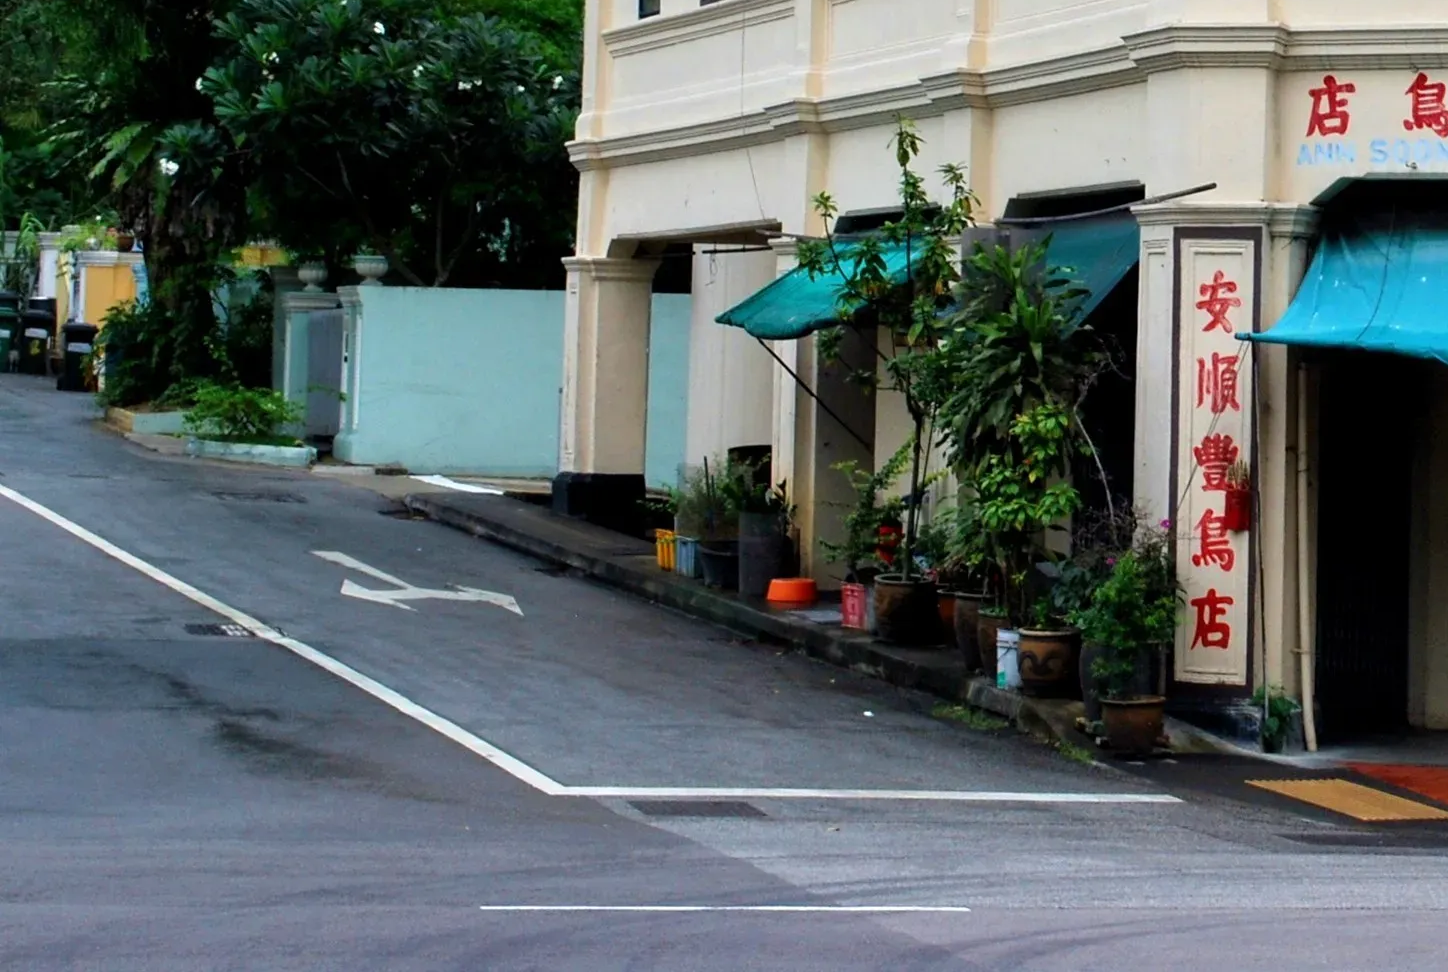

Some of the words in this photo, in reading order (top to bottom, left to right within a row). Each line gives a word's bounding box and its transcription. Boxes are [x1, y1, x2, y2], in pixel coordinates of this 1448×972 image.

[1190, 269, 1241, 652] 安順豐鳥店
